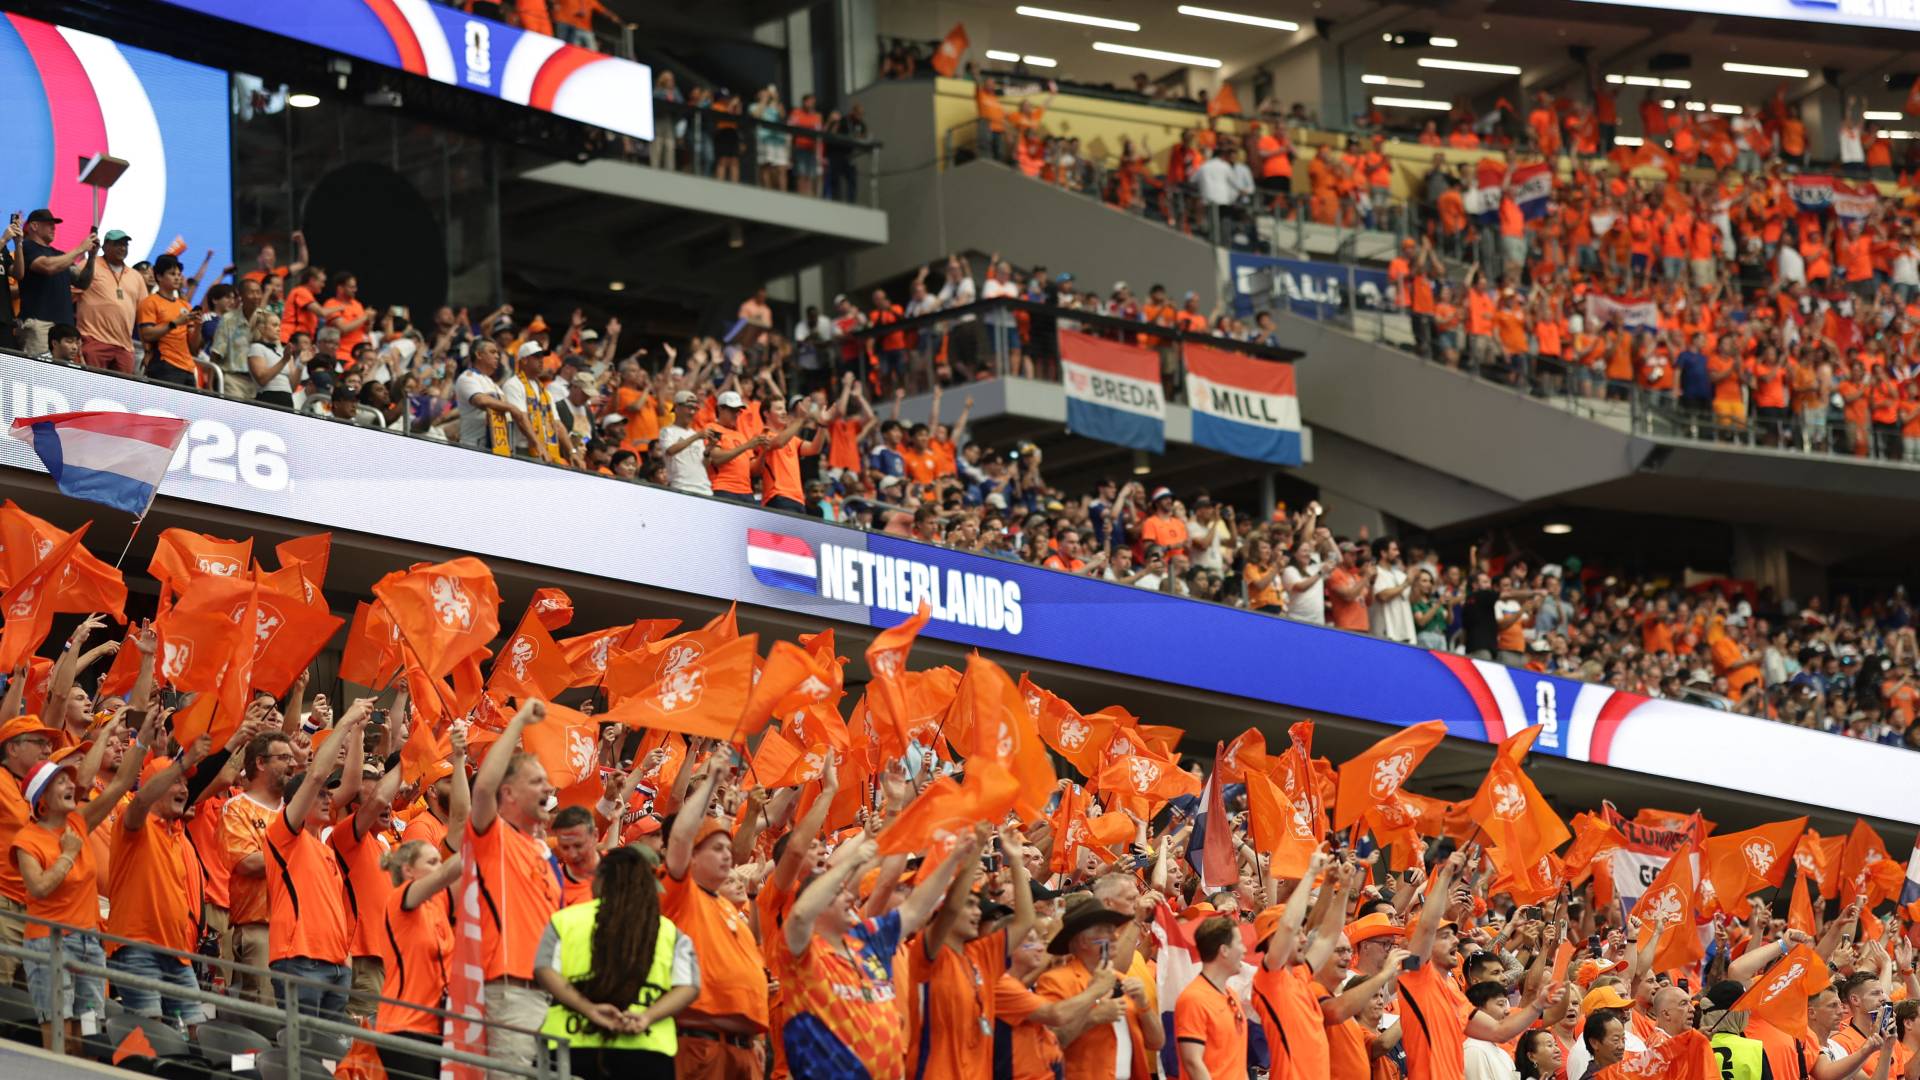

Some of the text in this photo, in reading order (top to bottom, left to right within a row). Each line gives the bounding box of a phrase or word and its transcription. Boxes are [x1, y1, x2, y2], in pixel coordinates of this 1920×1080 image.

[1091, 376, 1160, 411] BREDA
[1210, 388, 1277, 423] MILL
[820, 543, 1023, 635] NETHERLANDS
